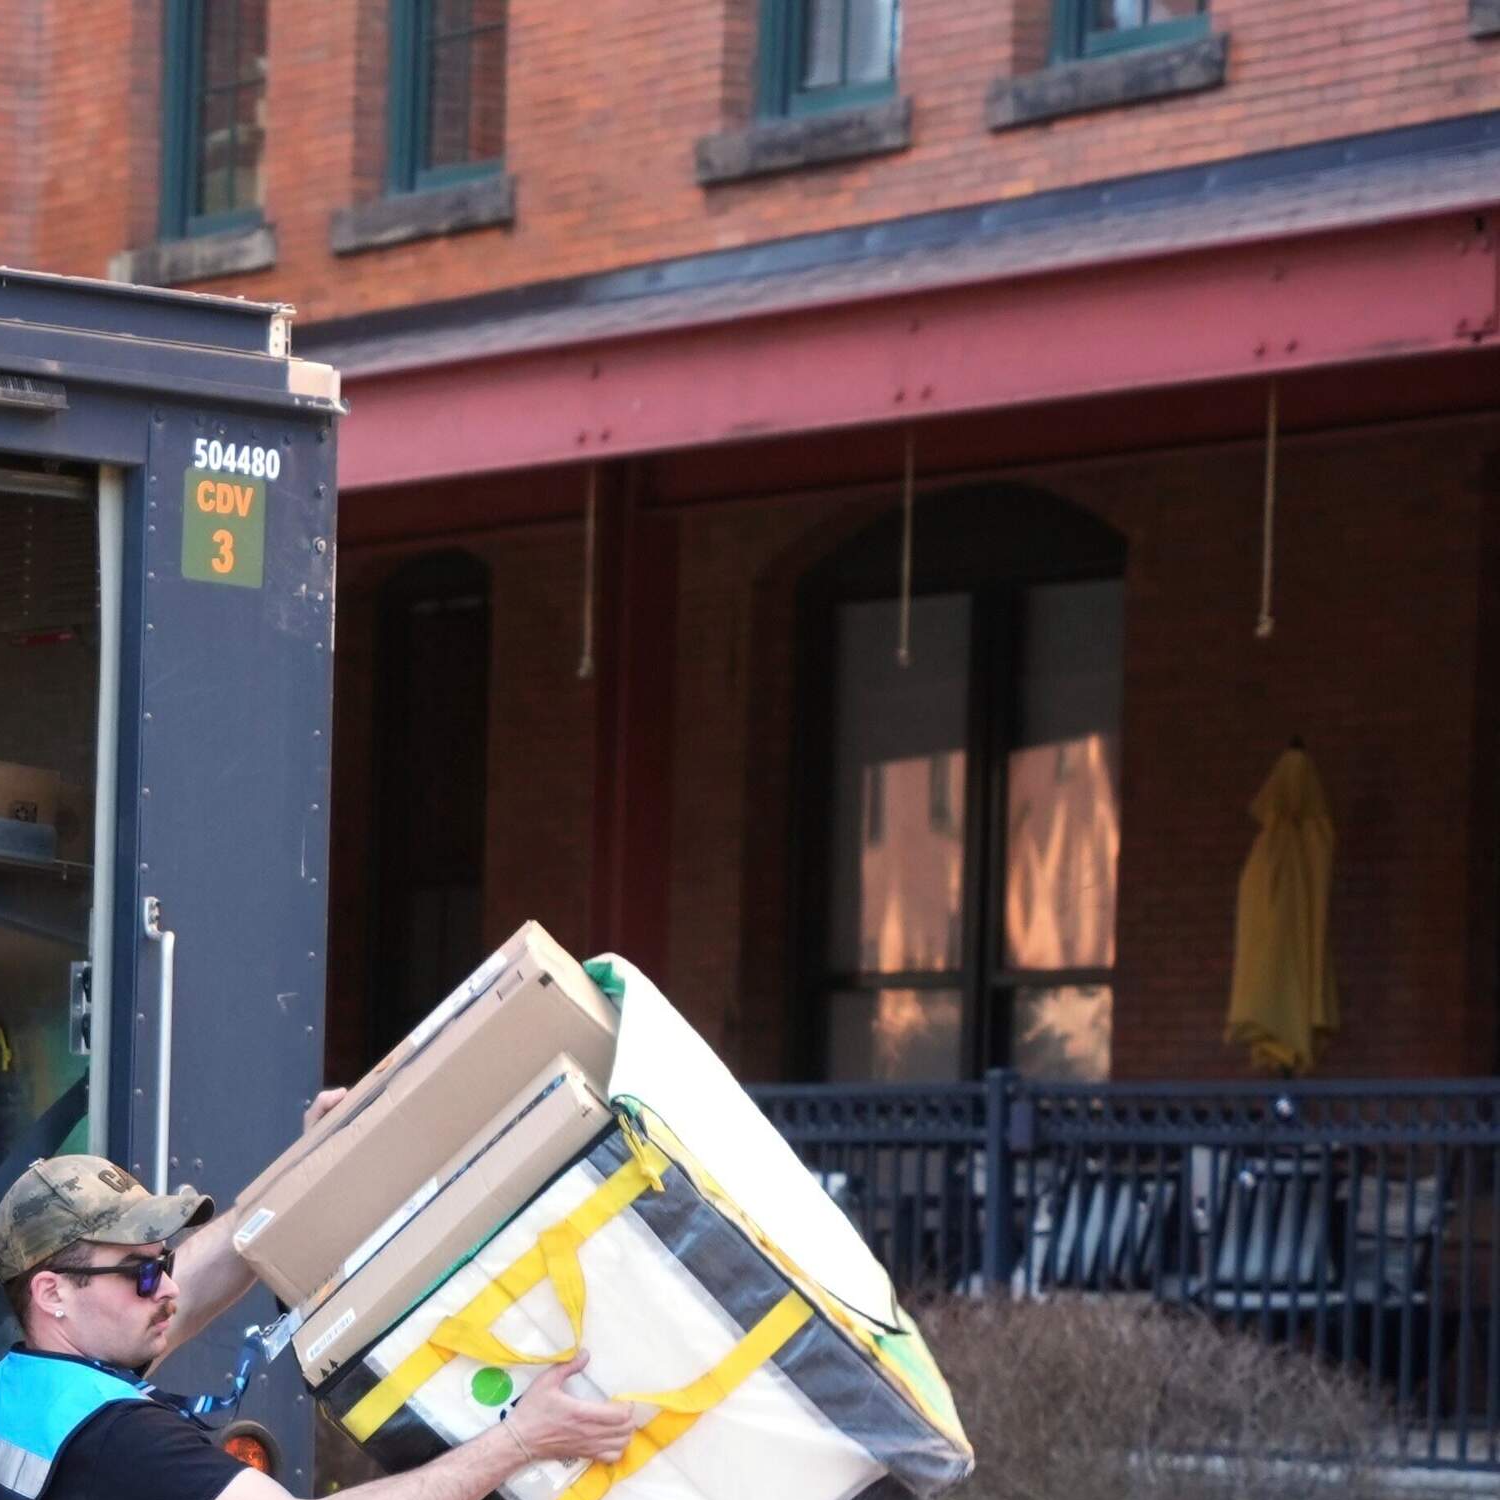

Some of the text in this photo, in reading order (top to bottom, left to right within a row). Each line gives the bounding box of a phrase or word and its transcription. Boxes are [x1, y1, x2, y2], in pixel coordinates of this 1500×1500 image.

[194, 438, 280, 479] 504480
[196, 480, 254, 517] CDV
[211, 529, 234, 573] 3
